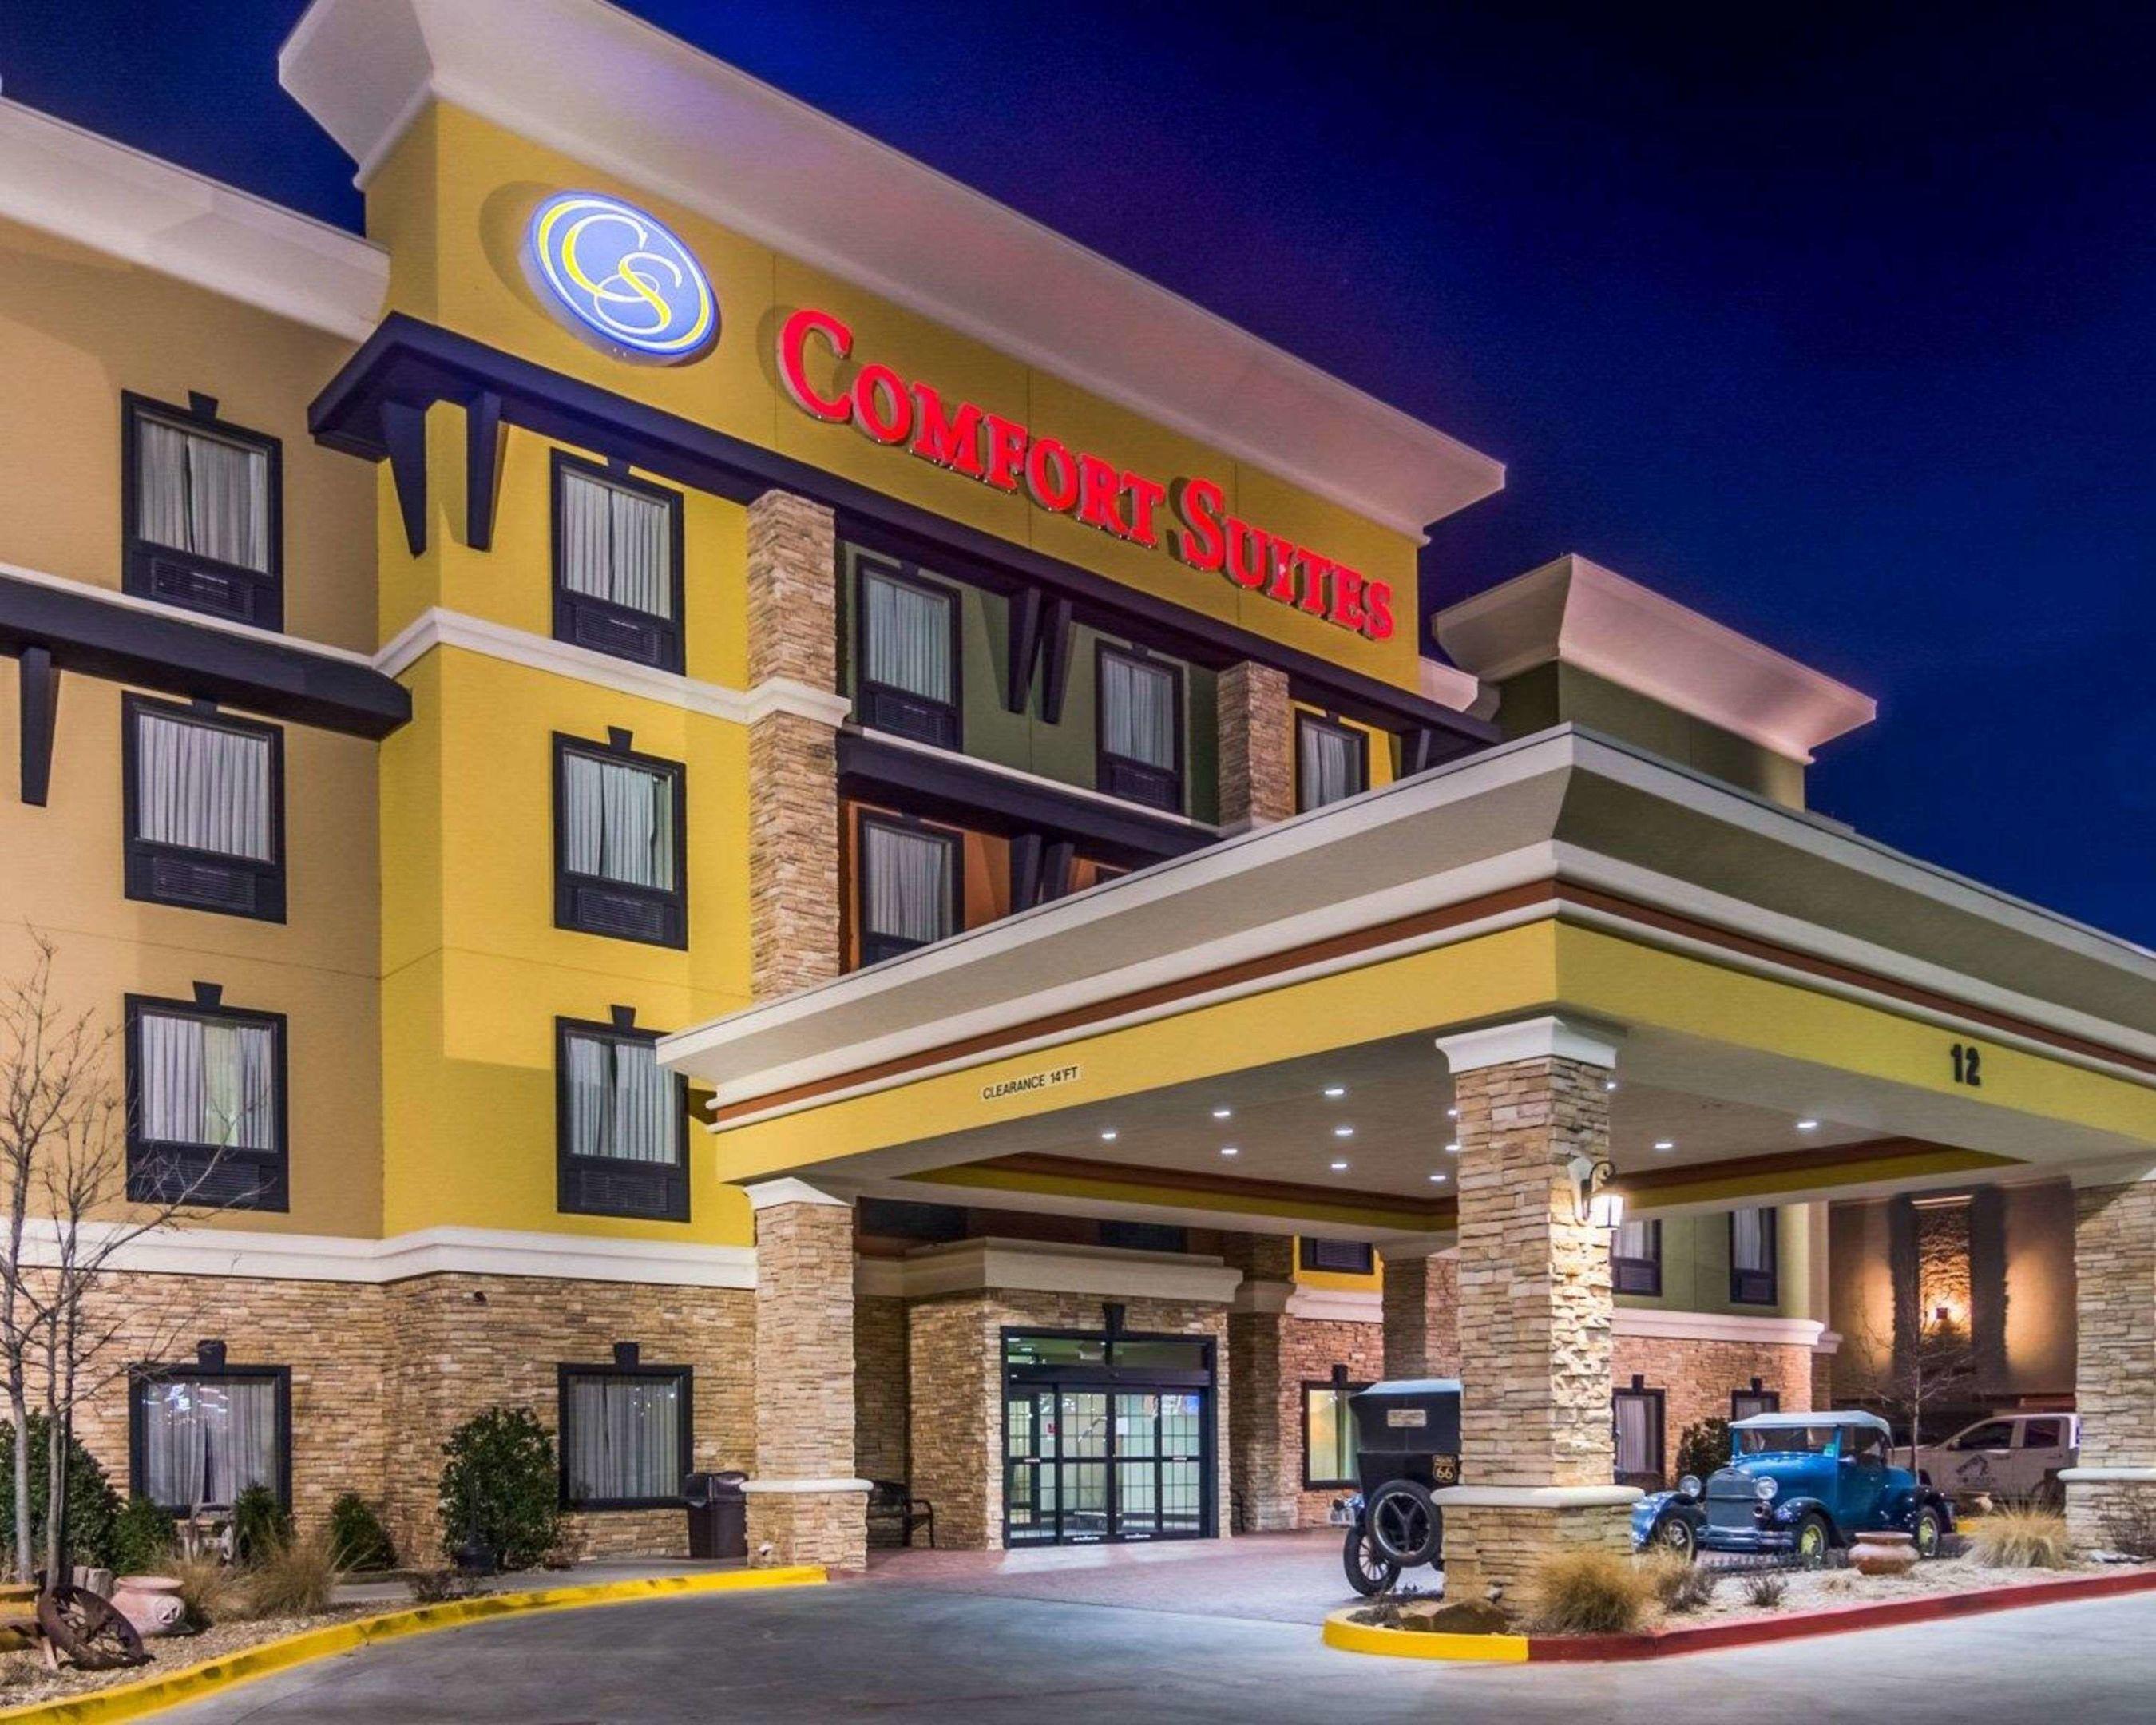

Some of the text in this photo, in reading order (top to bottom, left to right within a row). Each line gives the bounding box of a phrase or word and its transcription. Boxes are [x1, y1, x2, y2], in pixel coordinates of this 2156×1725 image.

[561, 213, 683, 335] CS
[777, 308, 1393, 640] COMFORT SUITES
[1950, 1044, 1980, 1085] 12
[982, 1074, 1045, 1099] CLEARANCE
[1437, 1466, 1453, 1480] 66
